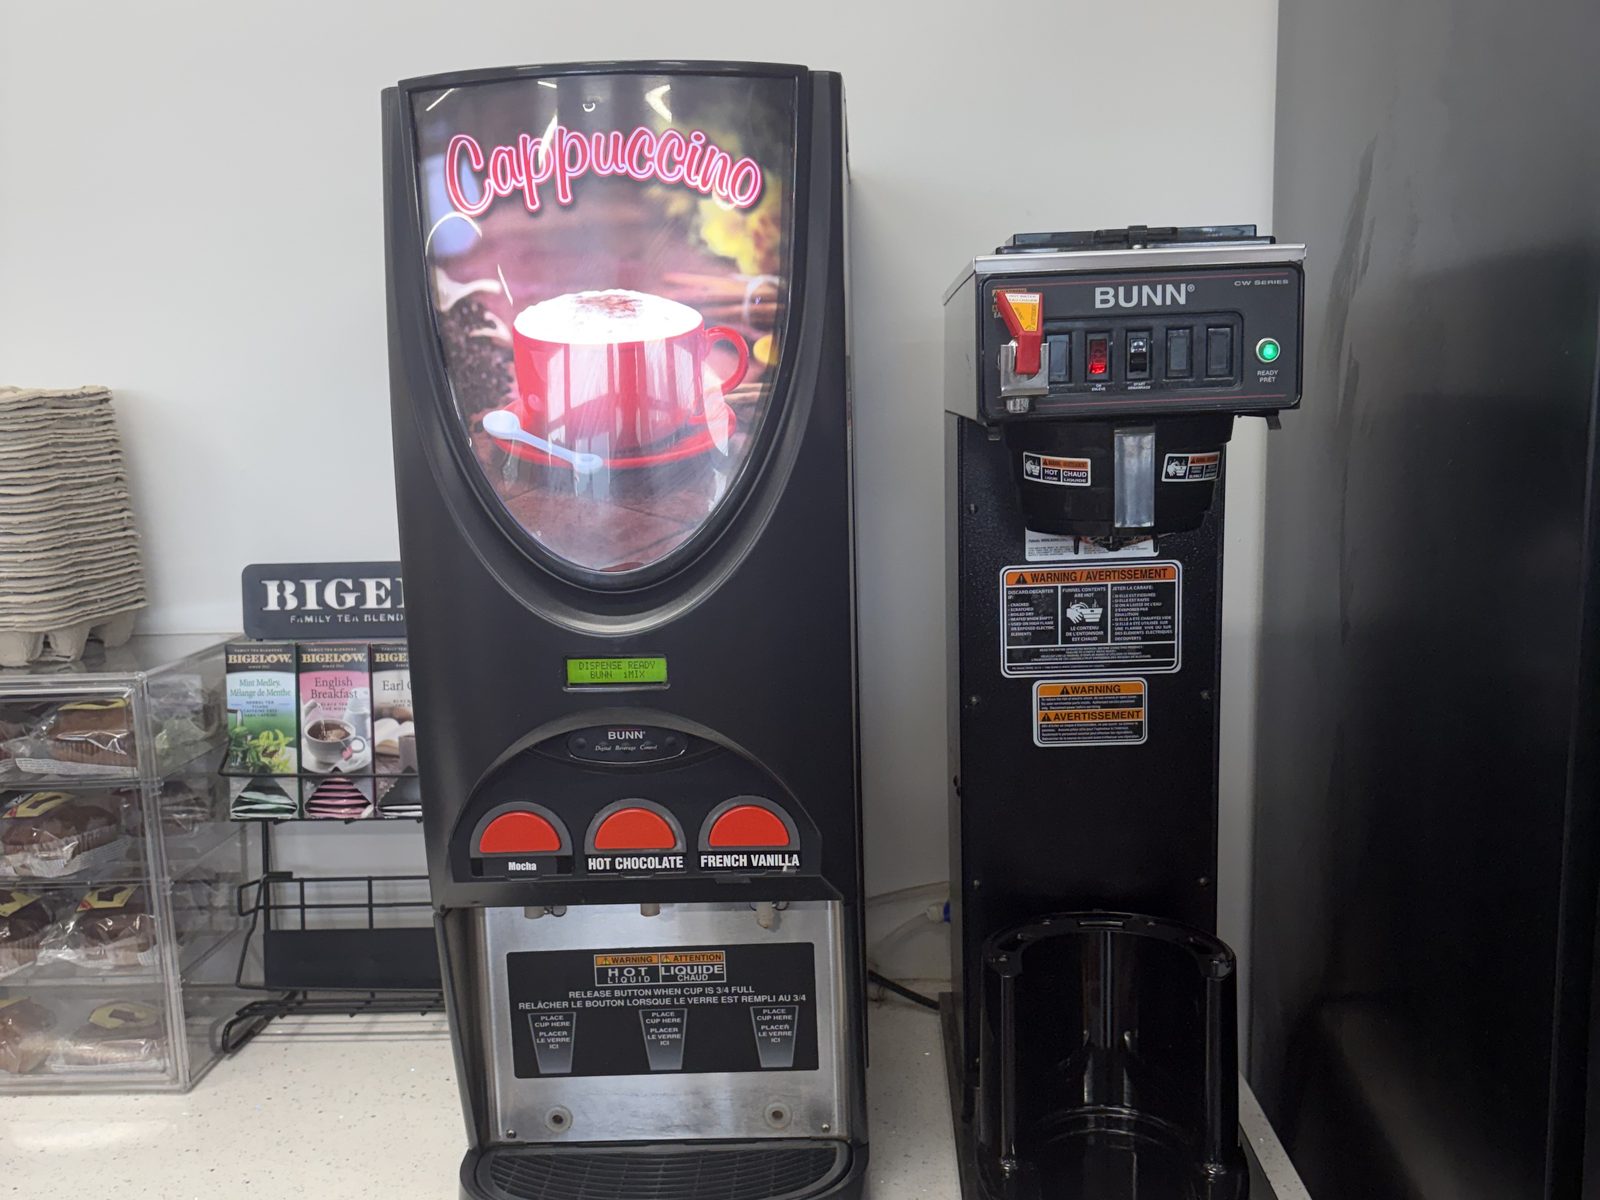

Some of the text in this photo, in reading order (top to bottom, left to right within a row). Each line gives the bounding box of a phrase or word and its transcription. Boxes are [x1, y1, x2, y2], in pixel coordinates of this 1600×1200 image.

[445, 126, 764, 217] Cappuccino
[1031, 571, 1077, 583] WARNING
[1086, 568, 1168, 581] AVERTISSEMENT
[290, 614, 332, 624] FAMILY
[337, 614, 359, 623] TEA
[375, 652, 409, 663] BIGE
[578, 660, 656, 671] DISPENSE READY
[590, 670, 613, 679] BUNN
[315, 677, 353, 690] English
[382, 680, 404, 691] Earl
[1071, 684, 1121, 694] WARNING
[311, 688, 358, 699] Breakfast
[1053, 711, 1141, 721] AVERTISSEMENT
[608, 731, 643, 740] BUNN
[508, 861, 537, 871] Mocha
[588, 856, 684, 871] HOT CHOCOLATE
[700, 853, 800, 868] FRENCH VANILLA
[611, 956, 653, 965] WARNING
[673, 952, 722, 962] ATTENTION
[607, 967, 648, 977] HOT
[661, 964, 724, 976] LIQUIDE
[607, 976, 651, 984] LIQUID
[677, 974, 708, 982] CHAUD
[569, 985, 755, 999] RELEASE BUTTON WHEN CUP IS 3/4 FULL
[571, 1000, 583, 1009] LE
[585, 999, 624, 1008] BOUTON
[626, 997, 671, 1006] LORSQUE
[674, 997, 686, 1005] LE
[687, 996, 719, 1004] VERRE
[721, 995, 738, 1003] EST
[741, 995, 776, 1003] REMPLI
[778, 994, 791, 1002] AU
[793, 994, 806, 1002] 3/4
